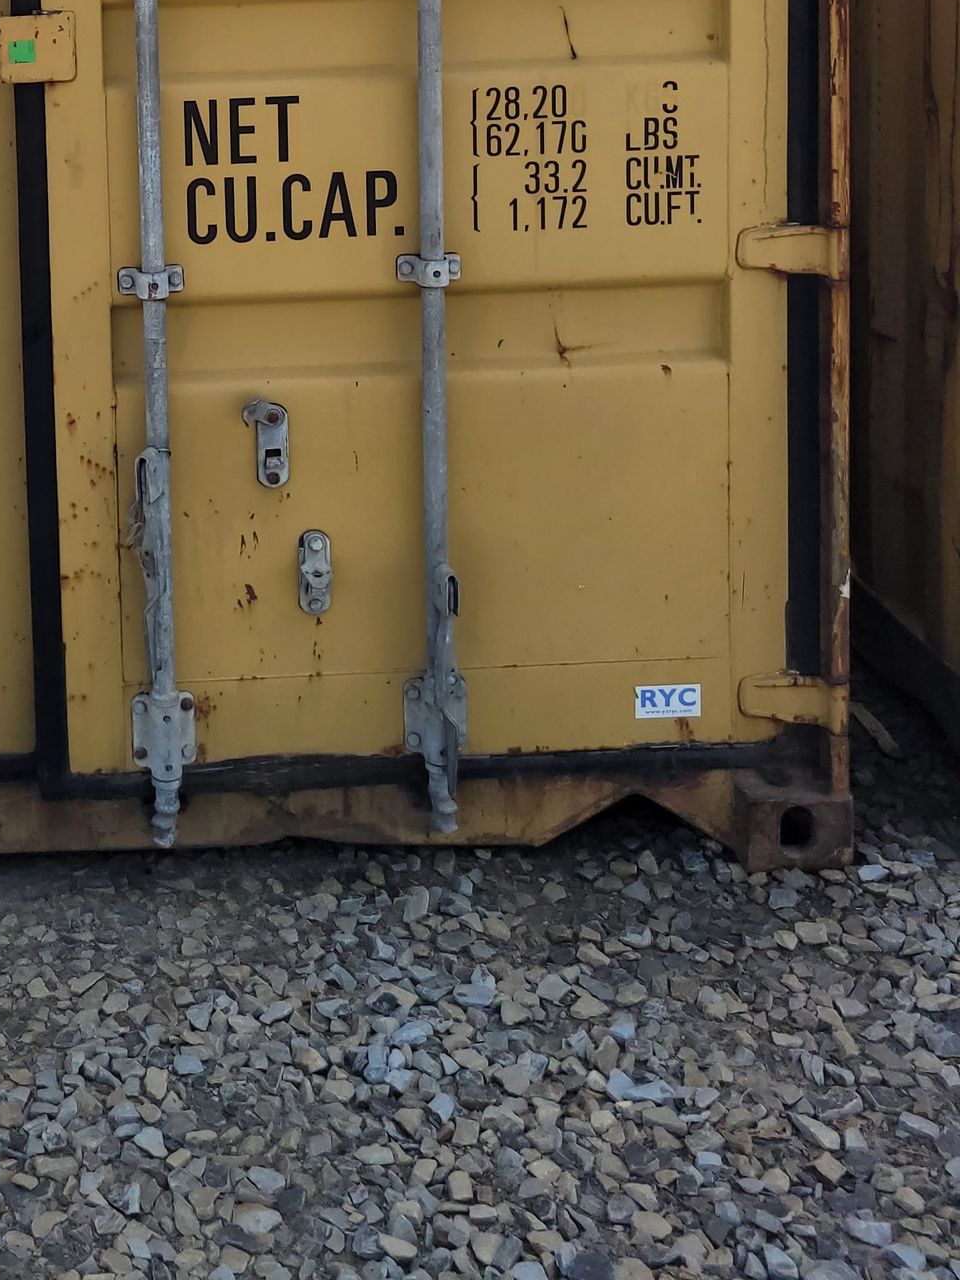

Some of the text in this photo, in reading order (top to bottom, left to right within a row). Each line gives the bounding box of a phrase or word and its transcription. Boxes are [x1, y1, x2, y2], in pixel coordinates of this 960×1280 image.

[485, 84, 586, 121] 28,20
[182, 95, 301, 167] NET
[625, 116, 678, 152] LBS
[524, 158, 588, 195] 33.2
[186, 170, 406, 246] CU.CAP.
[508, 195, 588, 232] 1,172
[640, 687, 697, 708] RYC
